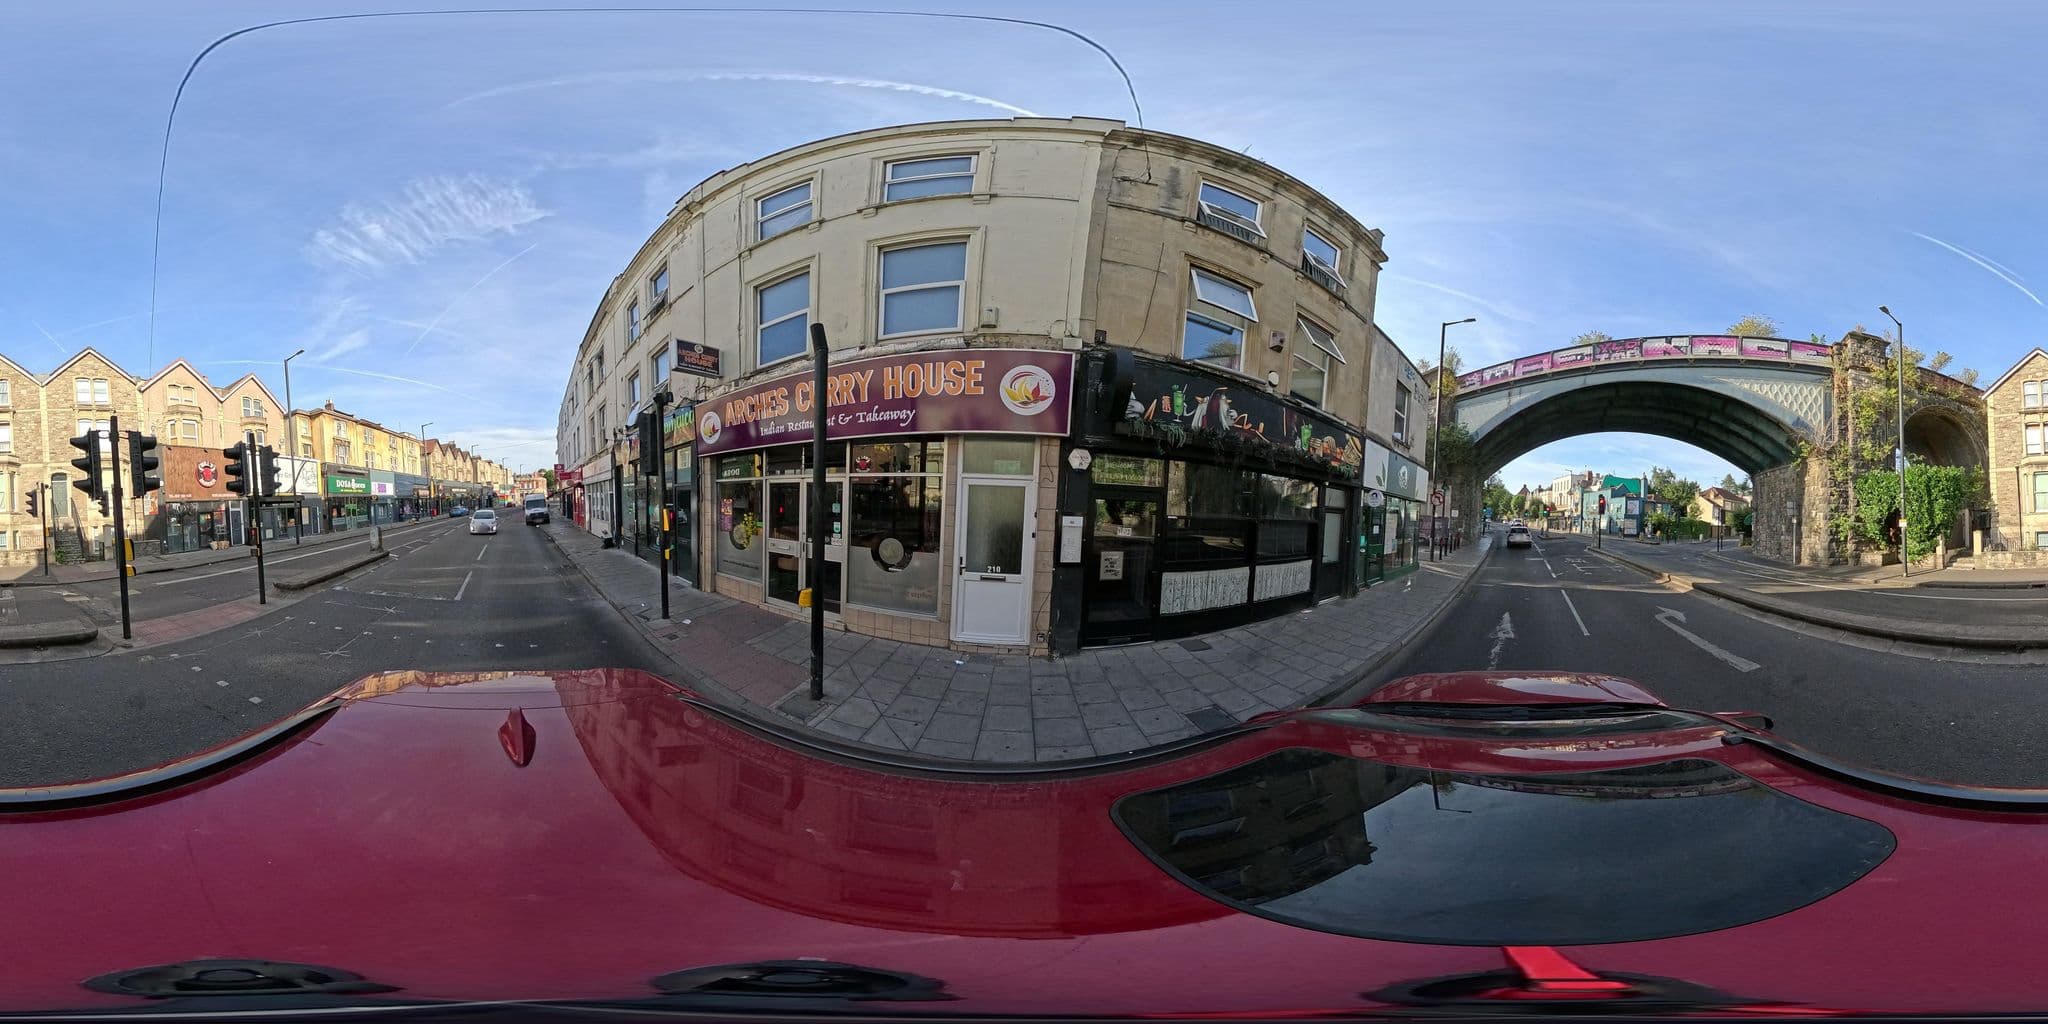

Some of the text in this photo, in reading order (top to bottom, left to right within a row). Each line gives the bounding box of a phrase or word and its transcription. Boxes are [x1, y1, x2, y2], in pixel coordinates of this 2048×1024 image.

[725, 387, 789, 427] ARCHES
[883, 360, 985, 401] HOUSE
[760, 421, 785, 436] Indian
[837, 413, 854, 425] &
[856, 405, 916, 427] Takeaway
